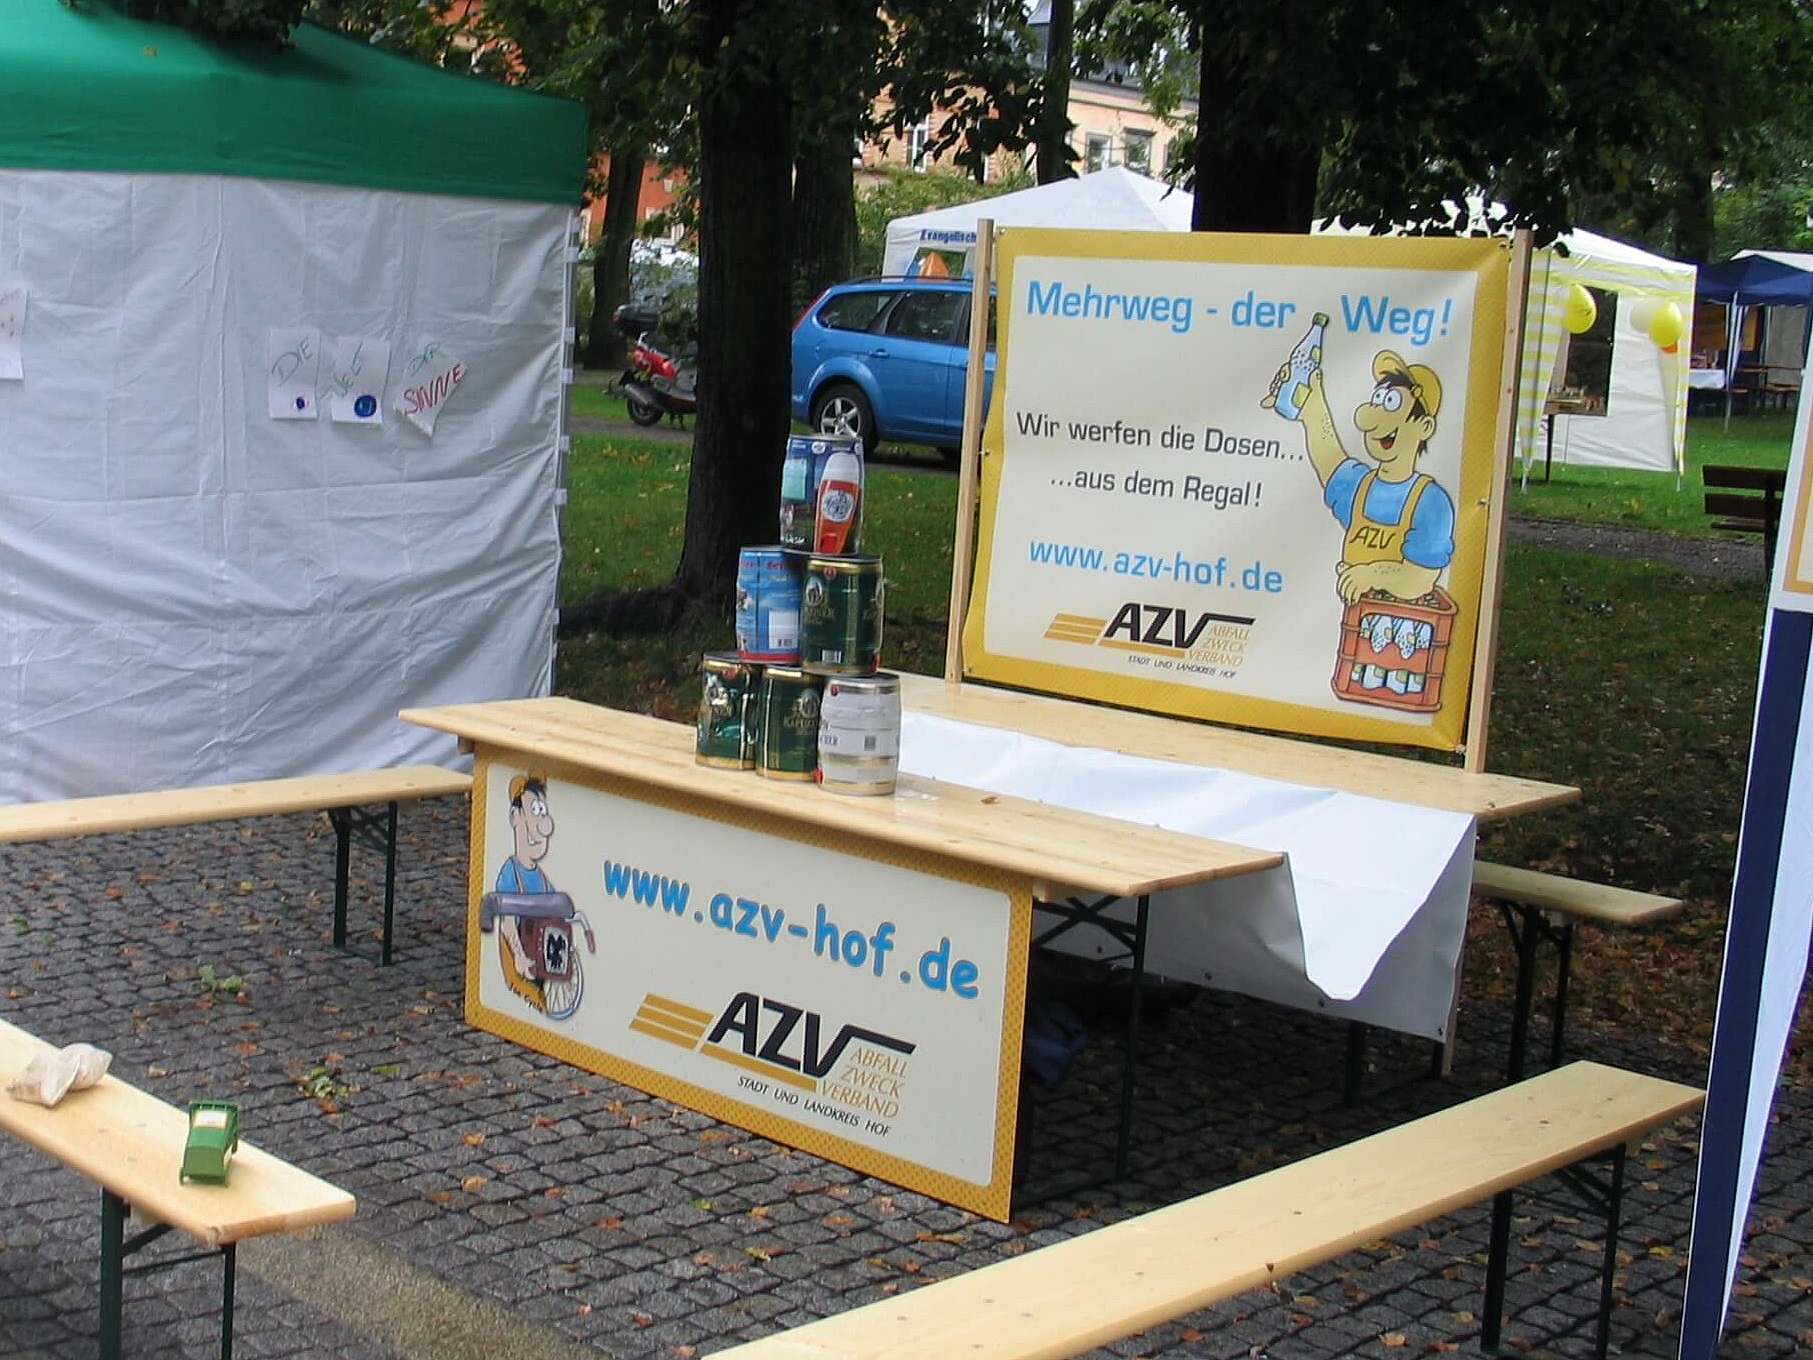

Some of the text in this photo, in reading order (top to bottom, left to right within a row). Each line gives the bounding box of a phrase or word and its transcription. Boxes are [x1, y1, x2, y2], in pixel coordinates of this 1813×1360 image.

[1027, 280, 1193, 333] Mehrweg
[1231, 290, 1297, 328] der
[1340, 294, 1453, 347] Weg!
[404, 363, 462, 416] SINNE
[1016, 411, 1304, 461] Wir werfen die Dosen...
[1051, 469, 1262, 510] ...aus dem Regal!
[1349, 526, 1396, 549] AZV
[1030, 540, 1283, 593] www.azv-hof.de
[1103, 602, 1256, 649] AZV
[1210, 624, 1251, 640] ABFALL
[1128, 655, 1151, 668] STADT
[1154, 659, 1173, 670] UND
[1188, 650, 1244, 668] VERBAND
[1202, 638, 1248, 655] ZWECK
[603, 859, 980, 999] www.azv-hof.de
[708, 992, 916, 1078] AZV
[841, 1064, 905, 1098] ZWECK
[851, 1047, 908, 1078] ABFALL
[737, 1076, 892, 1137] STADT UND LANDKREIS HOF
[821, 1080, 899, 1118] VERBAND
